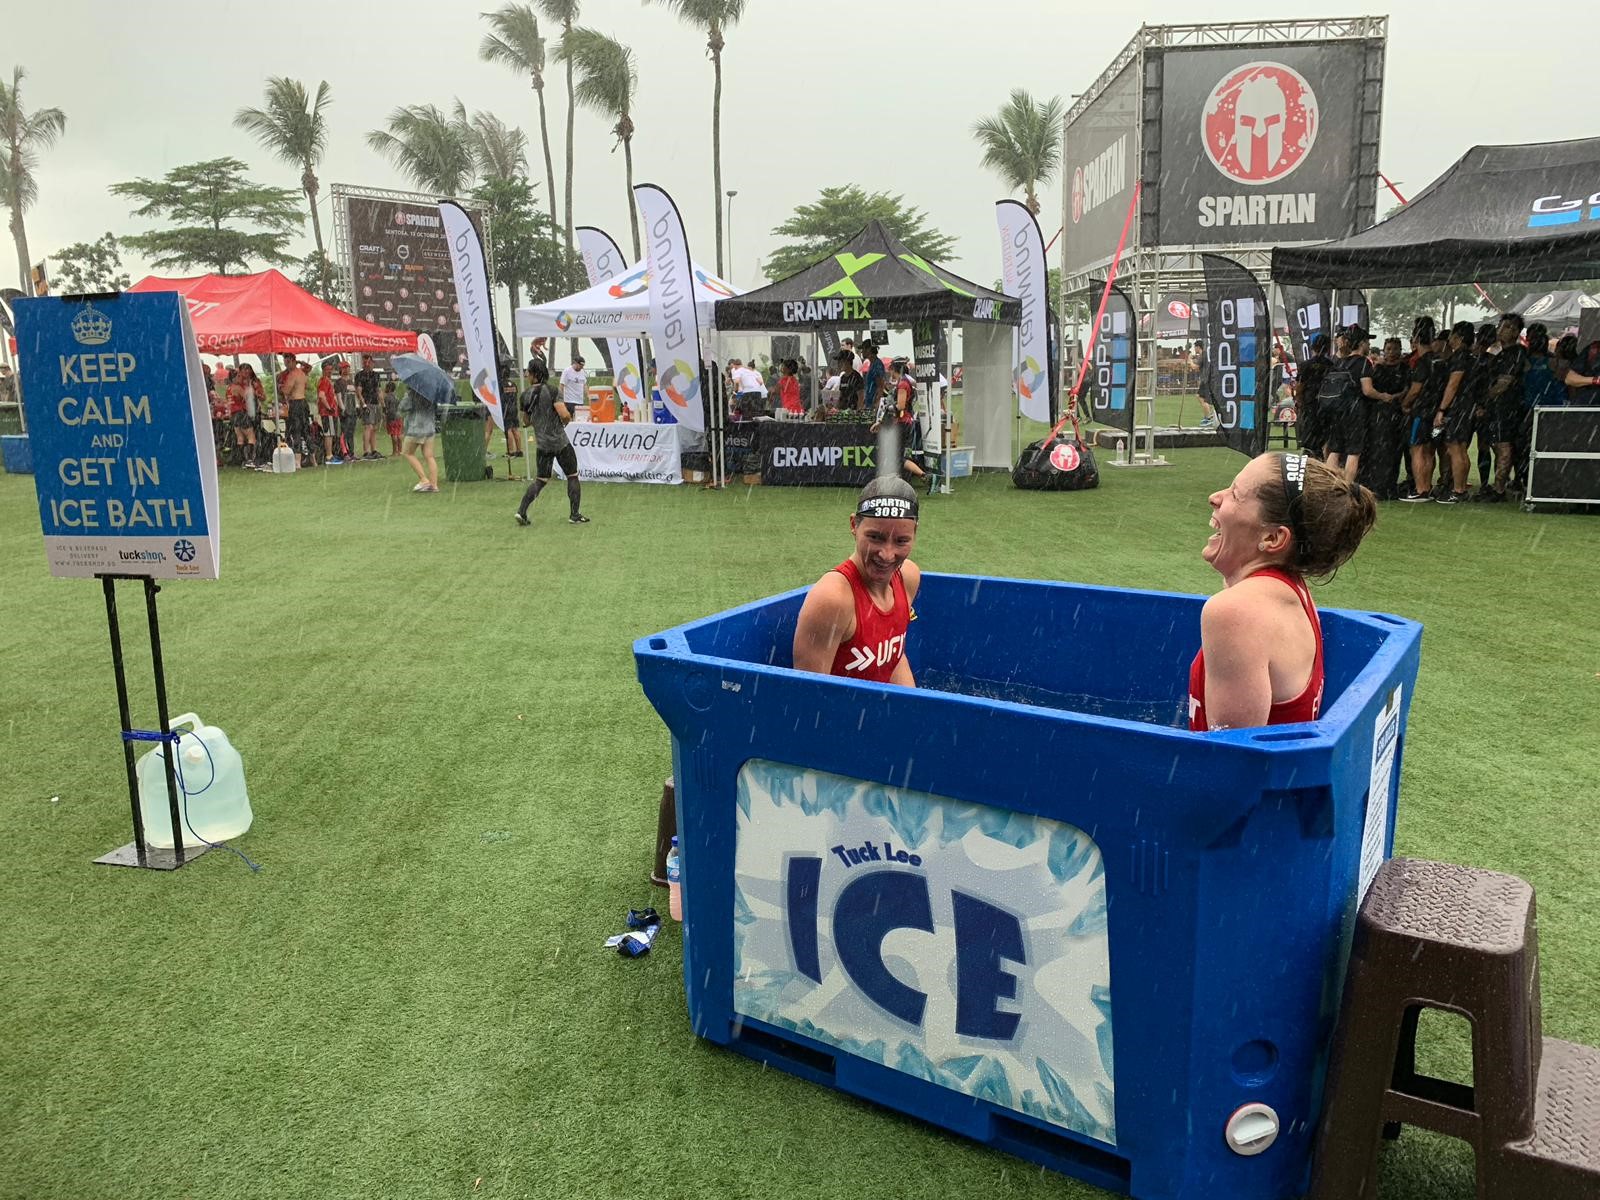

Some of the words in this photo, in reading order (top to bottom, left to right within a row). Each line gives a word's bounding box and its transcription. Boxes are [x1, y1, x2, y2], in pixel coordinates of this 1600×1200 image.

[1082, 134, 1127, 215] SPARTAN
[405, 213, 440, 228] SPARTAN
[1198, 193, 1316, 227] SPARTAN
[575, 312, 622, 325] tailwind
[624, 312, 650, 321] NUTRIT
[783, 298, 873, 322] CRAMPFIX
[282, 331, 408, 348] www.ufitclinic.com
[59, 352, 136, 384] KEEP
[1095, 313, 1112, 410] GoPro
[1218, 299, 1238, 429] GoPro
[58, 395, 152, 426] CALM
[91, 435, 124, 448] AND
[572, 427, 659, 450] tailwind
[773, 446, 877, 468] CRAMPFIX
[58, 457, 115, 486] GET
[127, 457, 160, 486] IN
[51, 499, 99, 528] ICE
[107, 499, 192, 528] BATH
[870, 498, 911, 510] SPARTAN
[874, 507, 905, 518] 3087
[876, 631, 907, 667] UFI
[831, 841, 881, 869] Tuck
[884, 841, 922, 867] Lee
[787, 856, 1027, 1041] ICE
